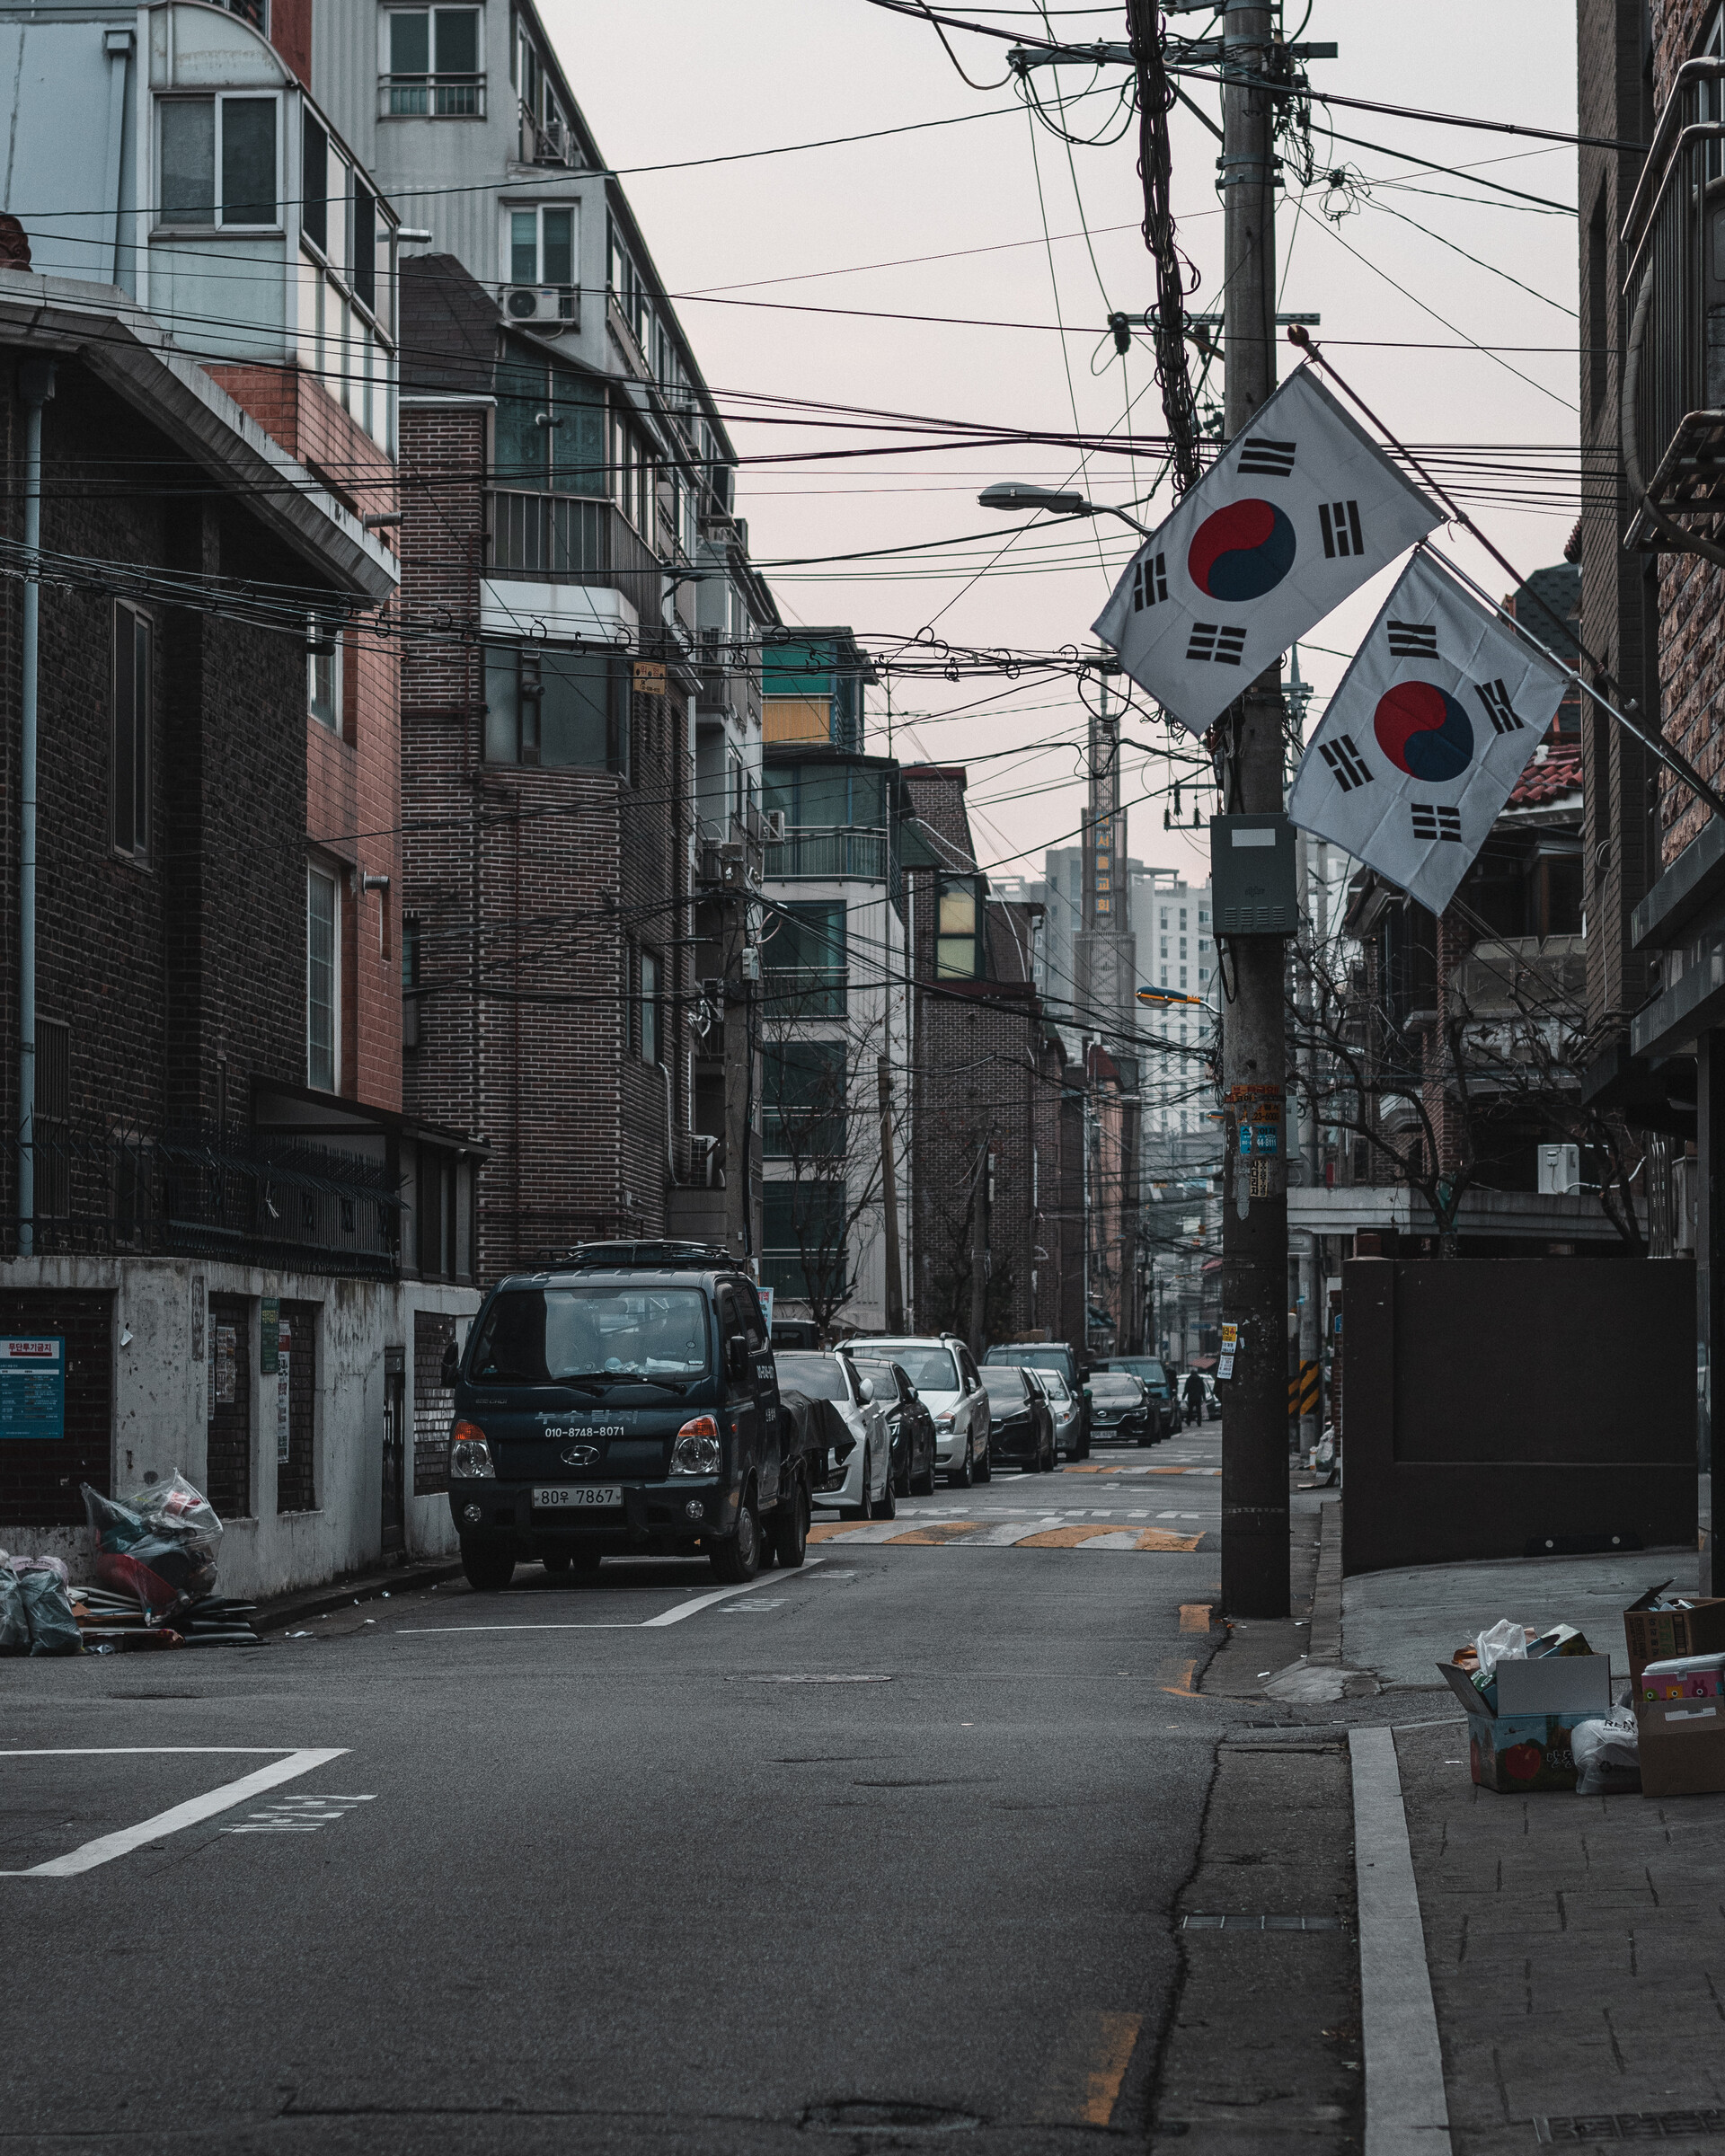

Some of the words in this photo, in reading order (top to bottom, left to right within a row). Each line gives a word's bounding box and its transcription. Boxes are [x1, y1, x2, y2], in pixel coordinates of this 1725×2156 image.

[8, 1343, 51, 1352] 무단투기금지
[534, 1409, 639, 1425] 누수탐지
[544, 1426, 624, 1437] 010-8748-8071
[541, 1490, 570, 1505] 80우
[576, 1489, 615, 1504] 7867
